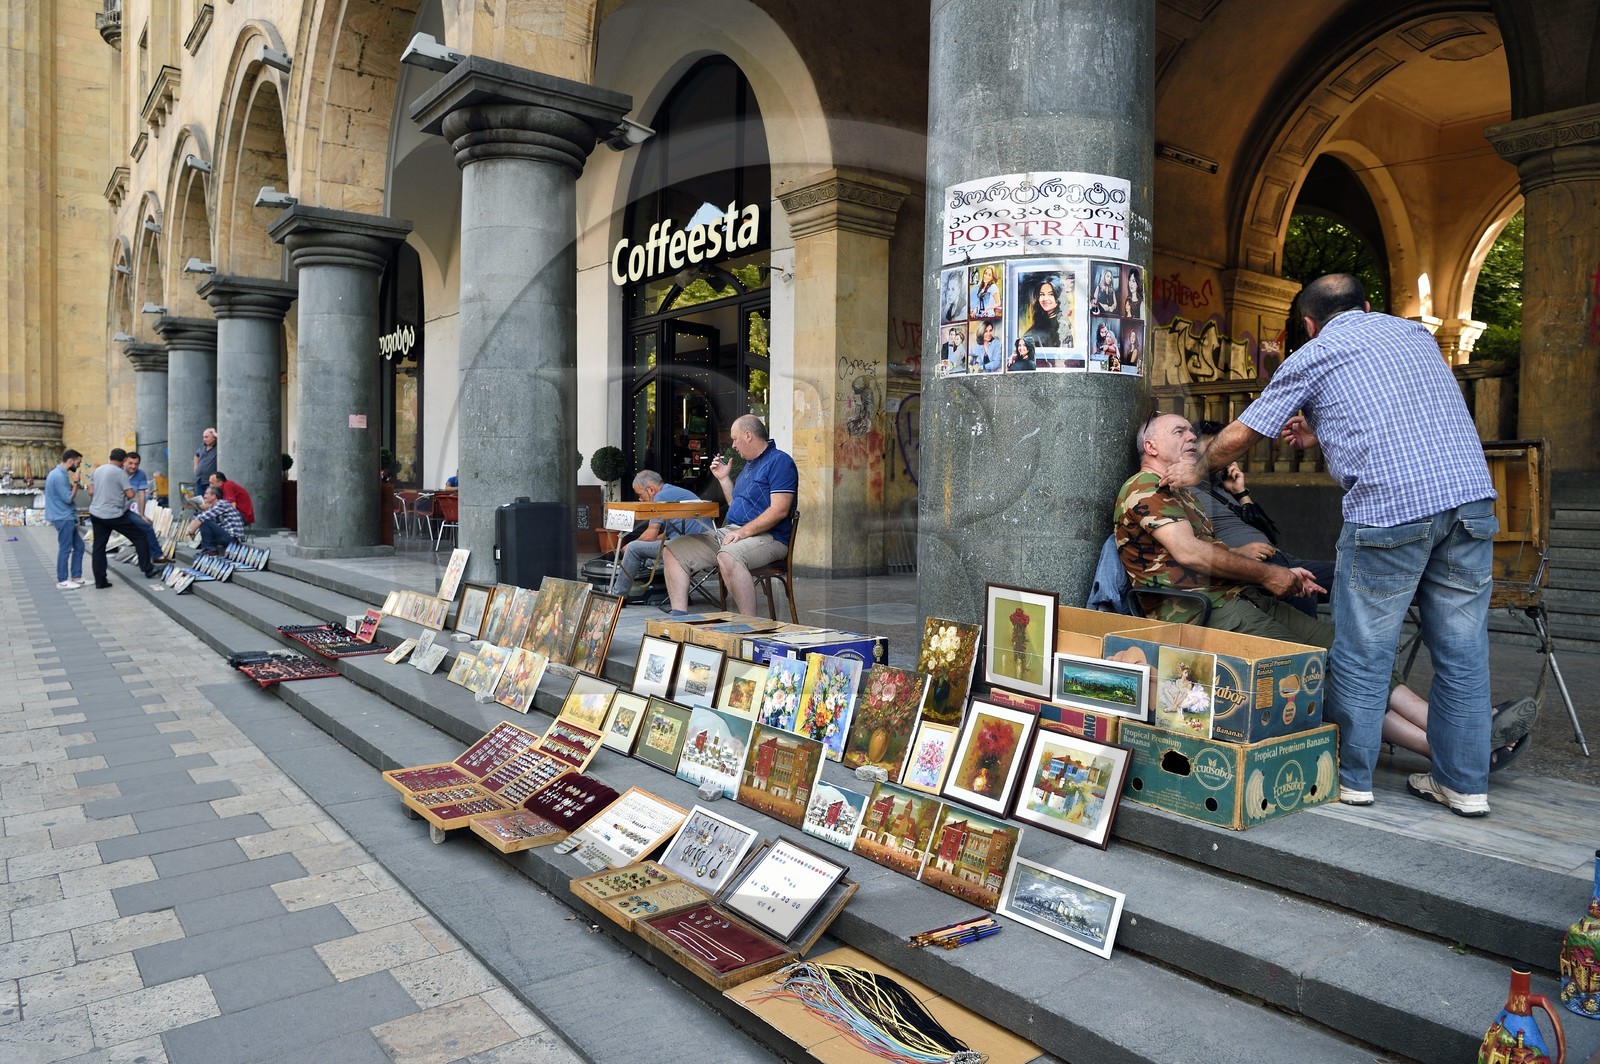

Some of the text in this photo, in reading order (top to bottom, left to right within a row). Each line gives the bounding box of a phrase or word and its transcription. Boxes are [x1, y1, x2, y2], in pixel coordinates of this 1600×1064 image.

[611, 200, 760, 286] Coffeesta
[949, 220, 1124, 246] PORTRAIT
[948, 238, 1121, 256] 557 998 661 JEMAL
[1123, 727, 1182, 748] Tropical Premium
[1123, 735, 1150, 748] Bananas
[1216, 726, 1244, 738] Bananas
[1254, 736, 1330, 762] Tropical Premium Bananas
[1191, 761, 1235, 781] Ecuasabor
